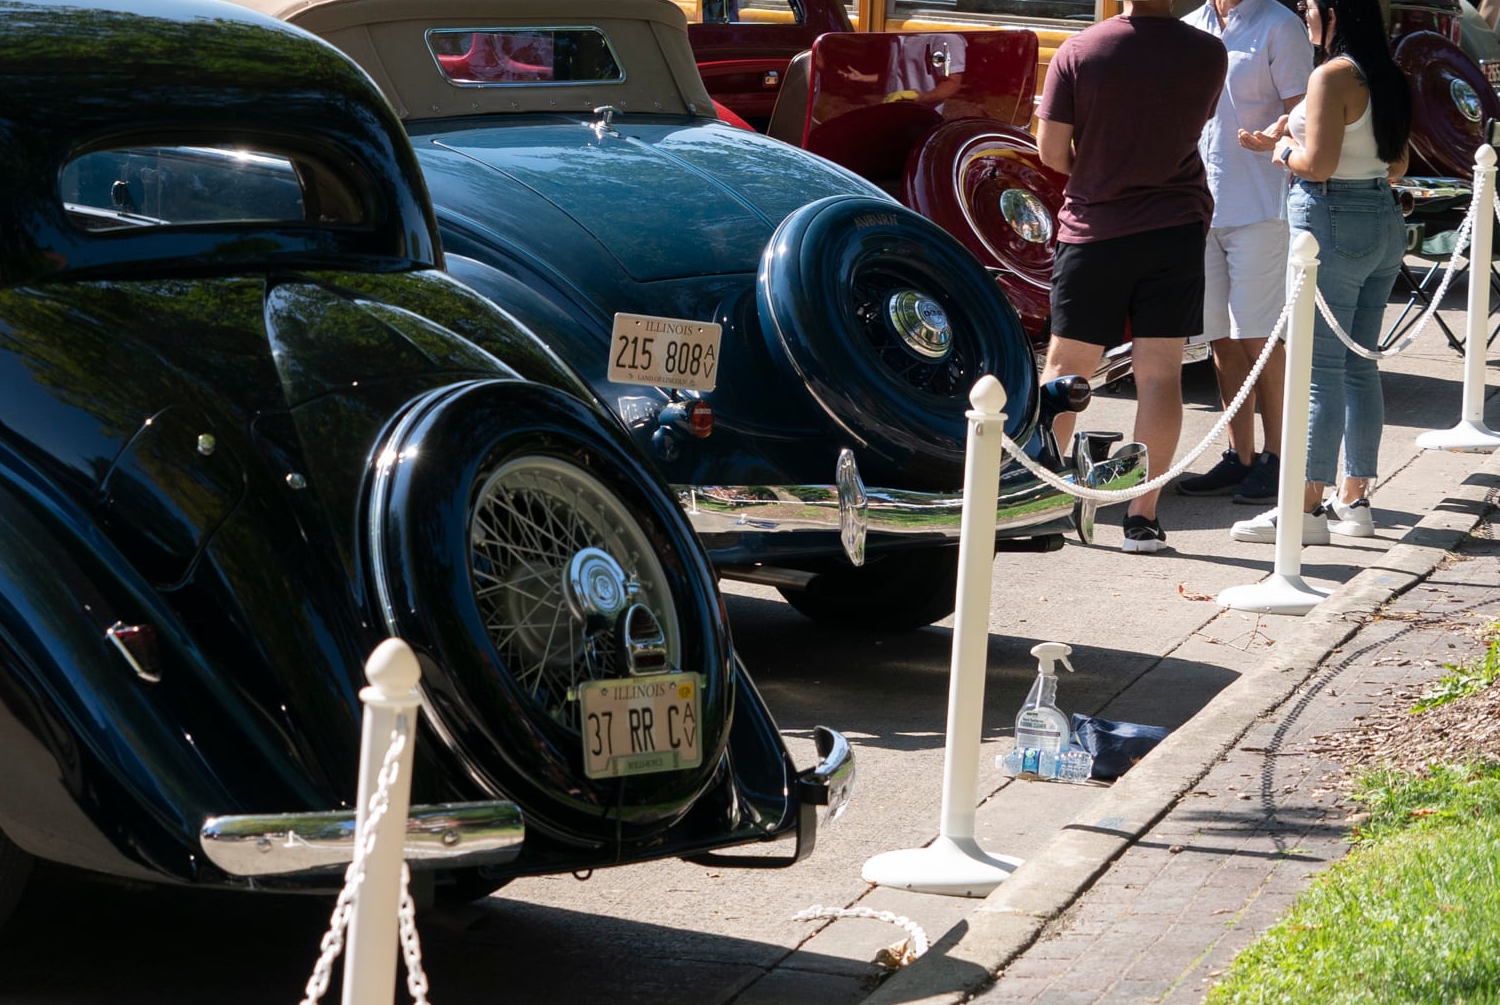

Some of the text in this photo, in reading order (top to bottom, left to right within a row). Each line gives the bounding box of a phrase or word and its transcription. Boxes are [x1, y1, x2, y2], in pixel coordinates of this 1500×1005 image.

[853, 213, 898, 230] AUBURN
[645, 321, 693, 335] ILLINOIS
[616, 335, 702, 376] 215 808
[614, 683, 665, 700] ILLINOIS
[587, 705, 681, 756] 37 RR C
